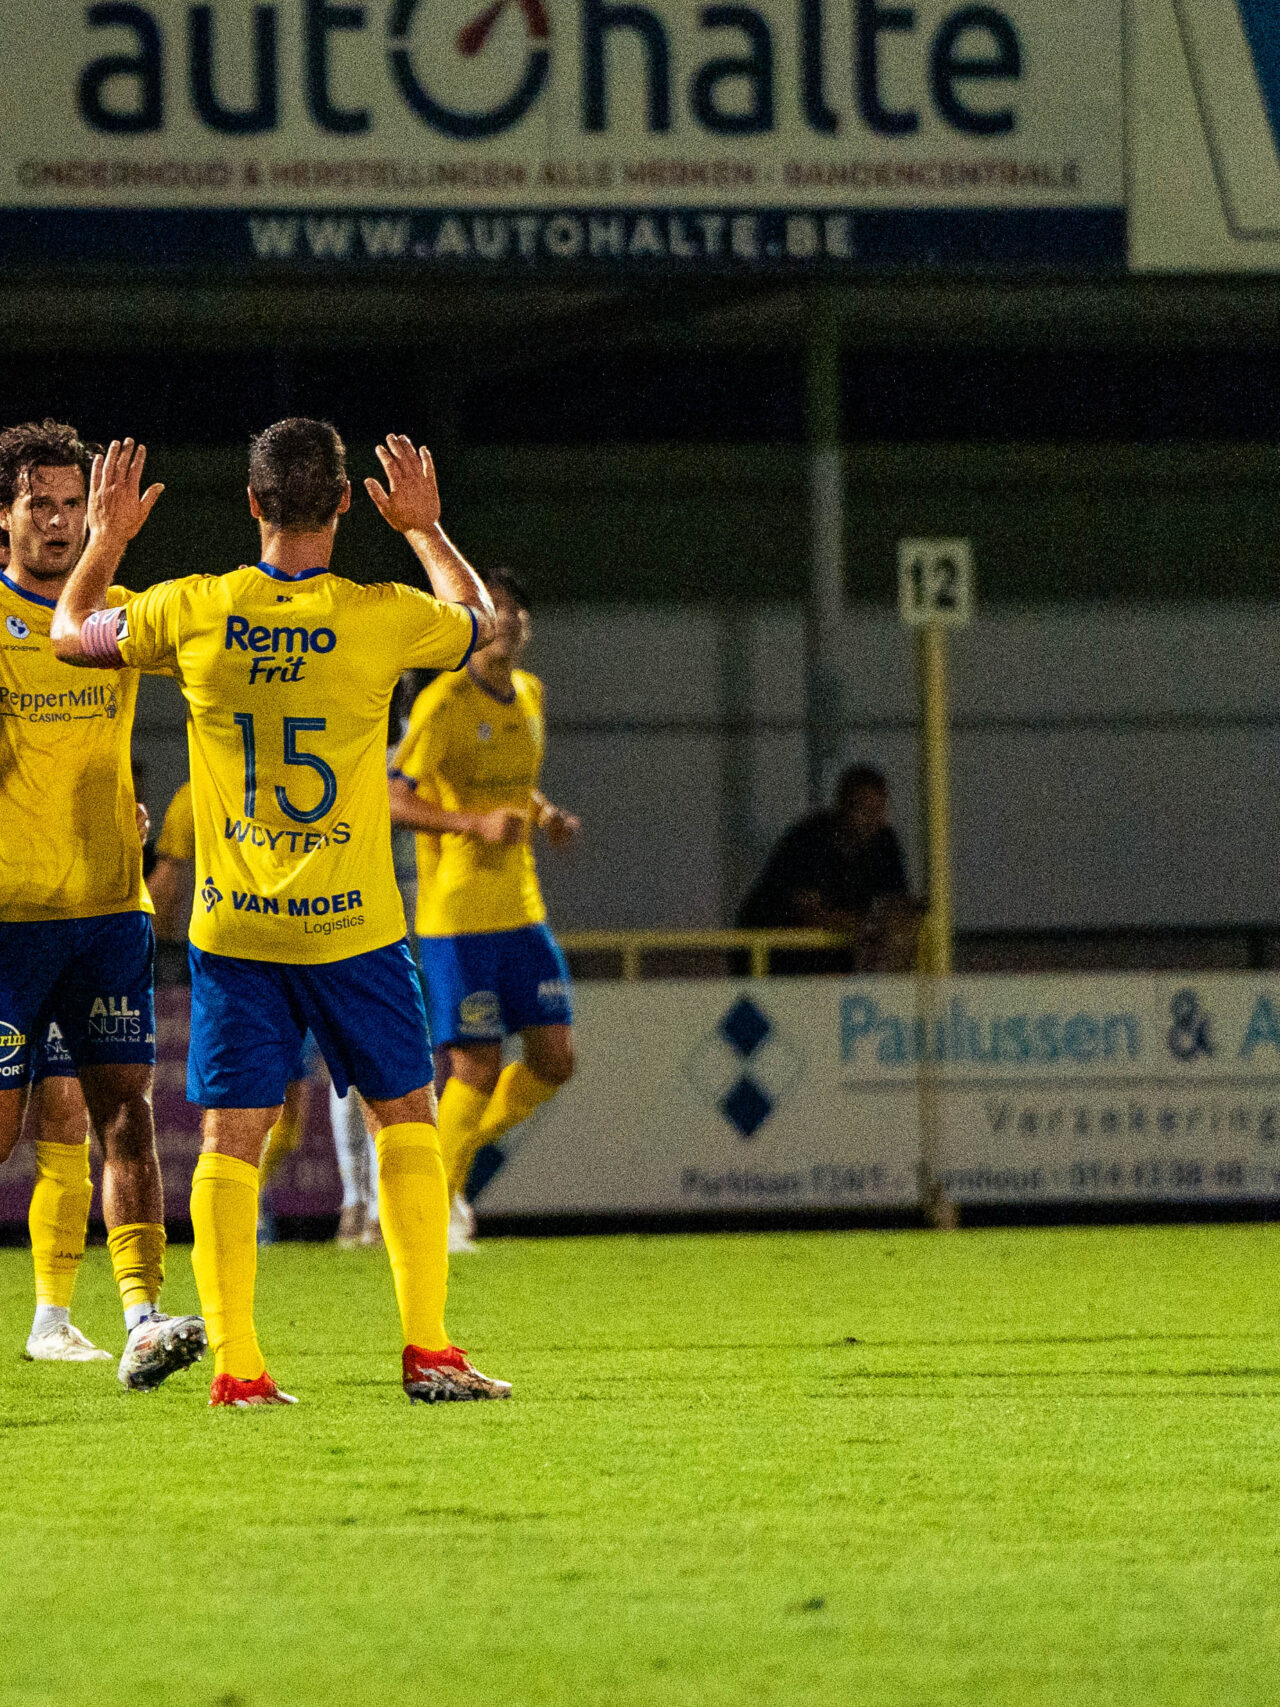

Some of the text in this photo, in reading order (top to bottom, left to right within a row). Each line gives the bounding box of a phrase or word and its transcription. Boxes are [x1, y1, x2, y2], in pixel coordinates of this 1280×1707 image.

[249, 216, 857, 259] WWW.AUTOHALTE.BE
[909, 556, 958, 610] 12
[225, 615, 337, 654] Remo
[249, 656, 307, 685] Frit
[29, 712, 71, 723] CASINO
[233, 711, 338, 825] 15
[231, 889, 364, 917] VAN MOER
[304, 914, 365, 936] Logistics
[89, 995, 141, 1018] ALL.
[88, 1016, 141, 1035] NUTS
[838, 994, 1141, 1064] Paulussen
[1167, 987, 1215, 1061] &
